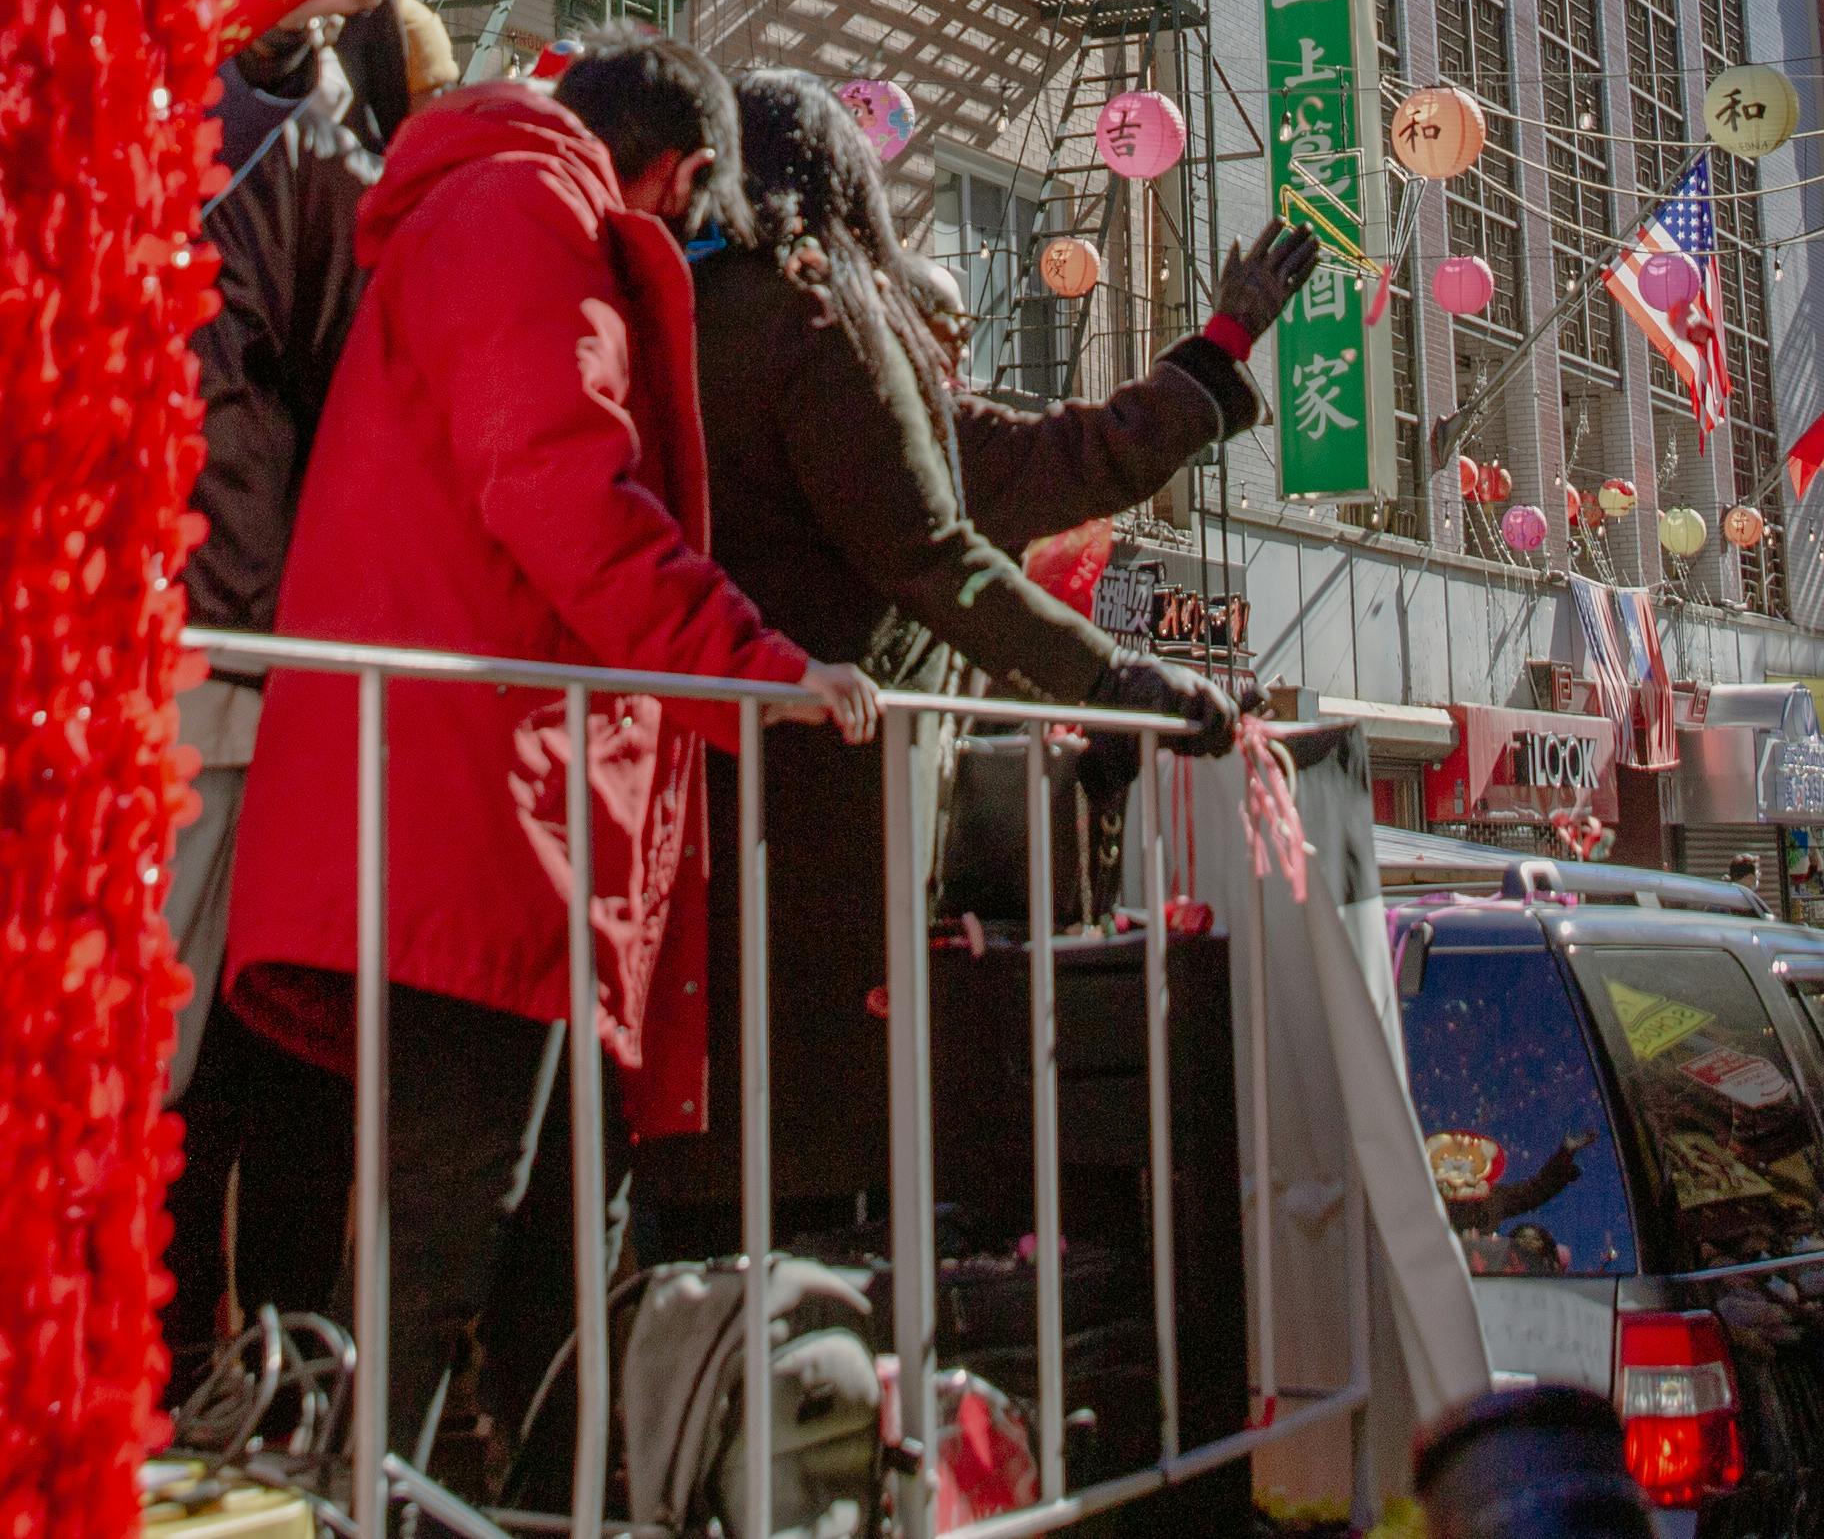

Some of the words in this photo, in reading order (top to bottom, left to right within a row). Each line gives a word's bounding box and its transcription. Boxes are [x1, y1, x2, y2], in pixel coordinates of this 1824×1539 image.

[1399, 111, 1442, 151] 和
[1714, 87, 1767, 133] 和
[1107, 110, 1143, 160] 吉
